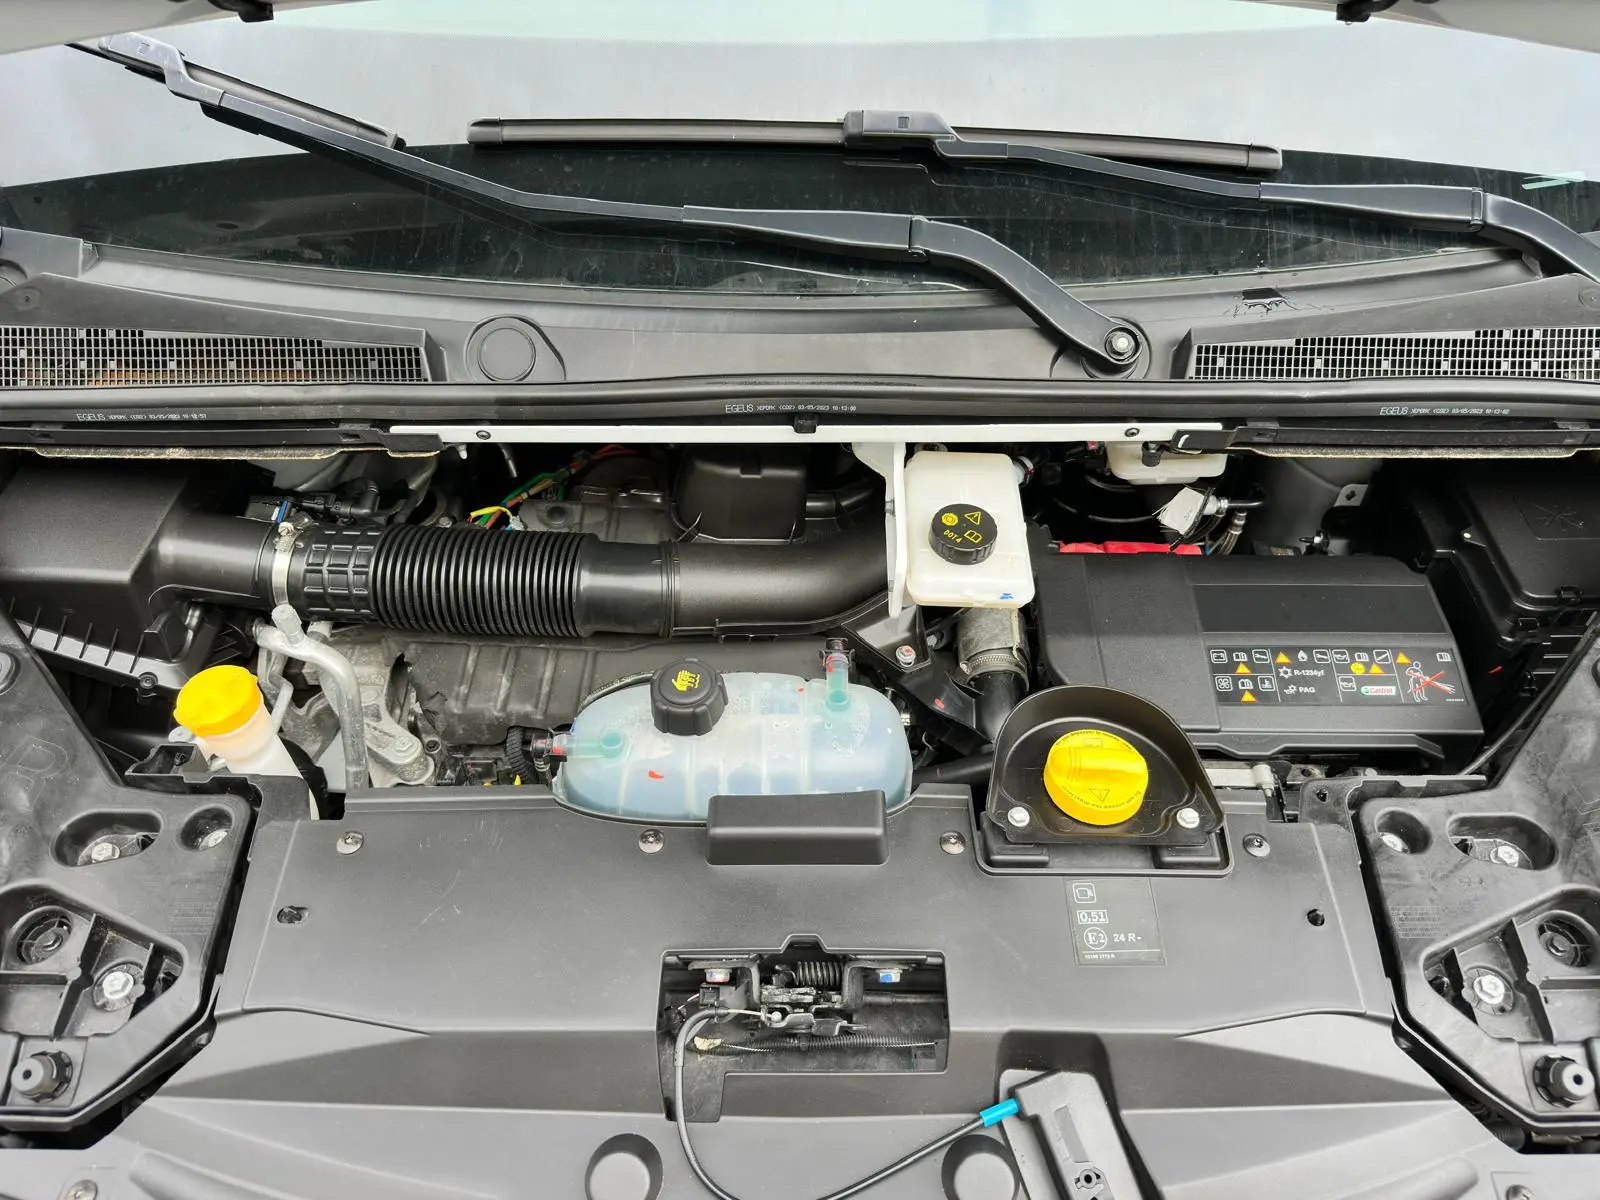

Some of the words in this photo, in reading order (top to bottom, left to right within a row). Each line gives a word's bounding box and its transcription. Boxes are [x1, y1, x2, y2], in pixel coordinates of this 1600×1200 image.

[725, 404, 754, 413] EGEUS
[1379, 406, 1409, 416] EGEUS
[76, 413, 106, 422] EGEUS
[1293, 669, 1325, 677] R-1234yf
[1079, 910, 1106, 923] 0,51
[1112, 933, 1126, 942] 24
